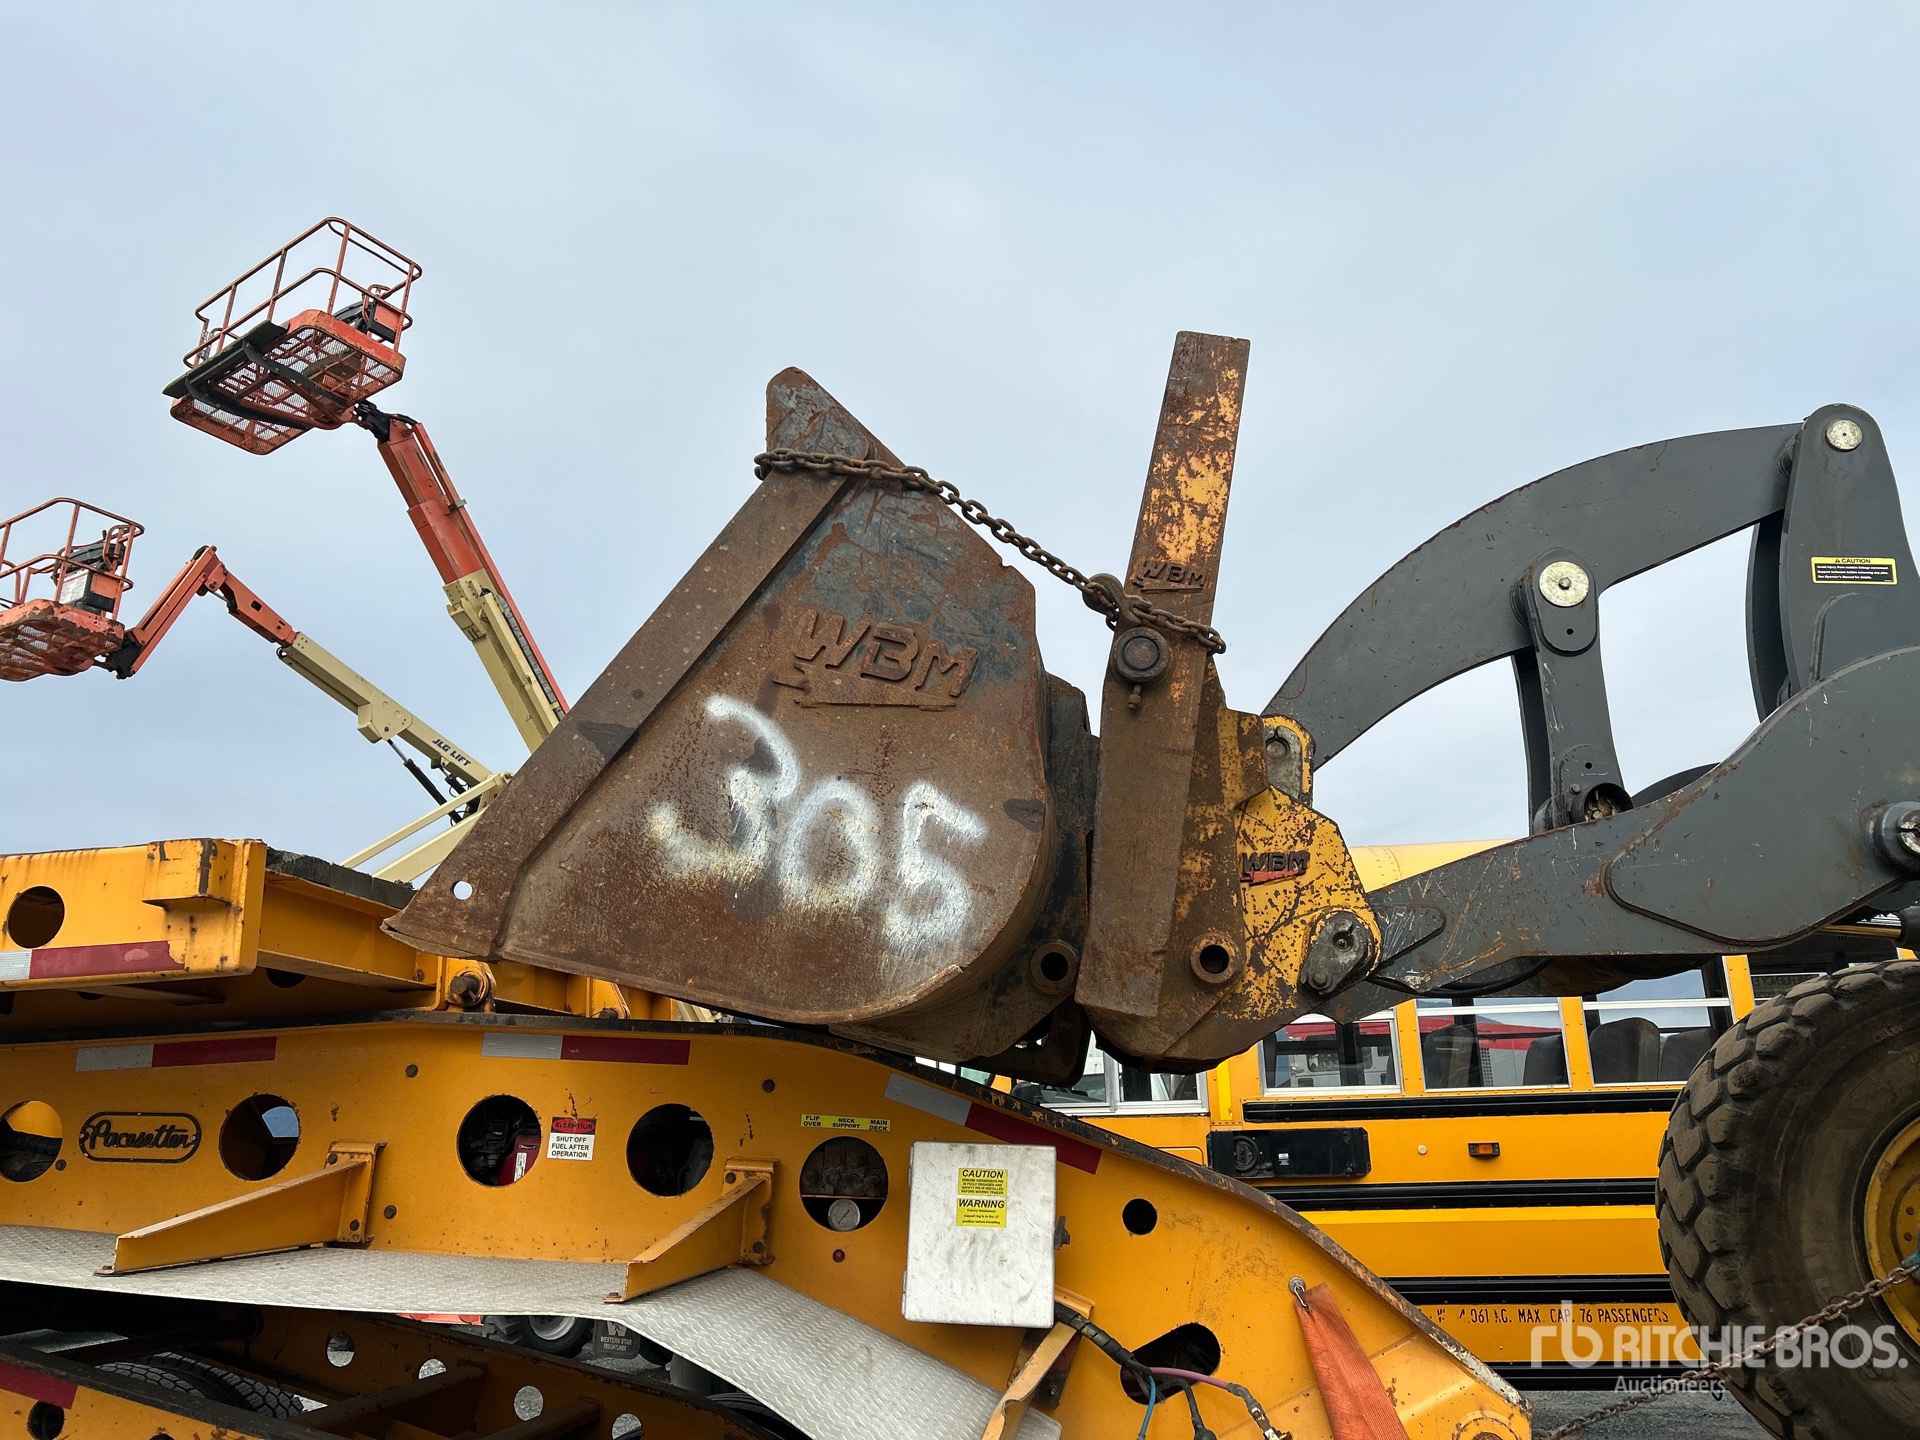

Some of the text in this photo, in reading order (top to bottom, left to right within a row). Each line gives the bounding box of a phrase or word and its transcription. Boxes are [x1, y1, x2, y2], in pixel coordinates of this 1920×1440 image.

[1137, 560, 1208, 587] WBM
[793, 610, 978, 698] WBM
[431, 738, 472, 767] JLG LIFT
[647, 694, 989, 948] 305
[1242, 850, 1312, 874] WBM
[555, 1122, 592, 1130] ATTENTION
[83, 1119, 195, 1150] Pacesetter
[556, 1135, 574, 1143] SHUT
[551, 1142, 590, 1151] FUEL AFTER
[551, 1150, 588, 1158] OPERATION
[962, 1169, 1004, 1179] CAUTION
[958, 1198, 1005, 1209] WARNING
[1579, 1308, 1593, 1323] 76
